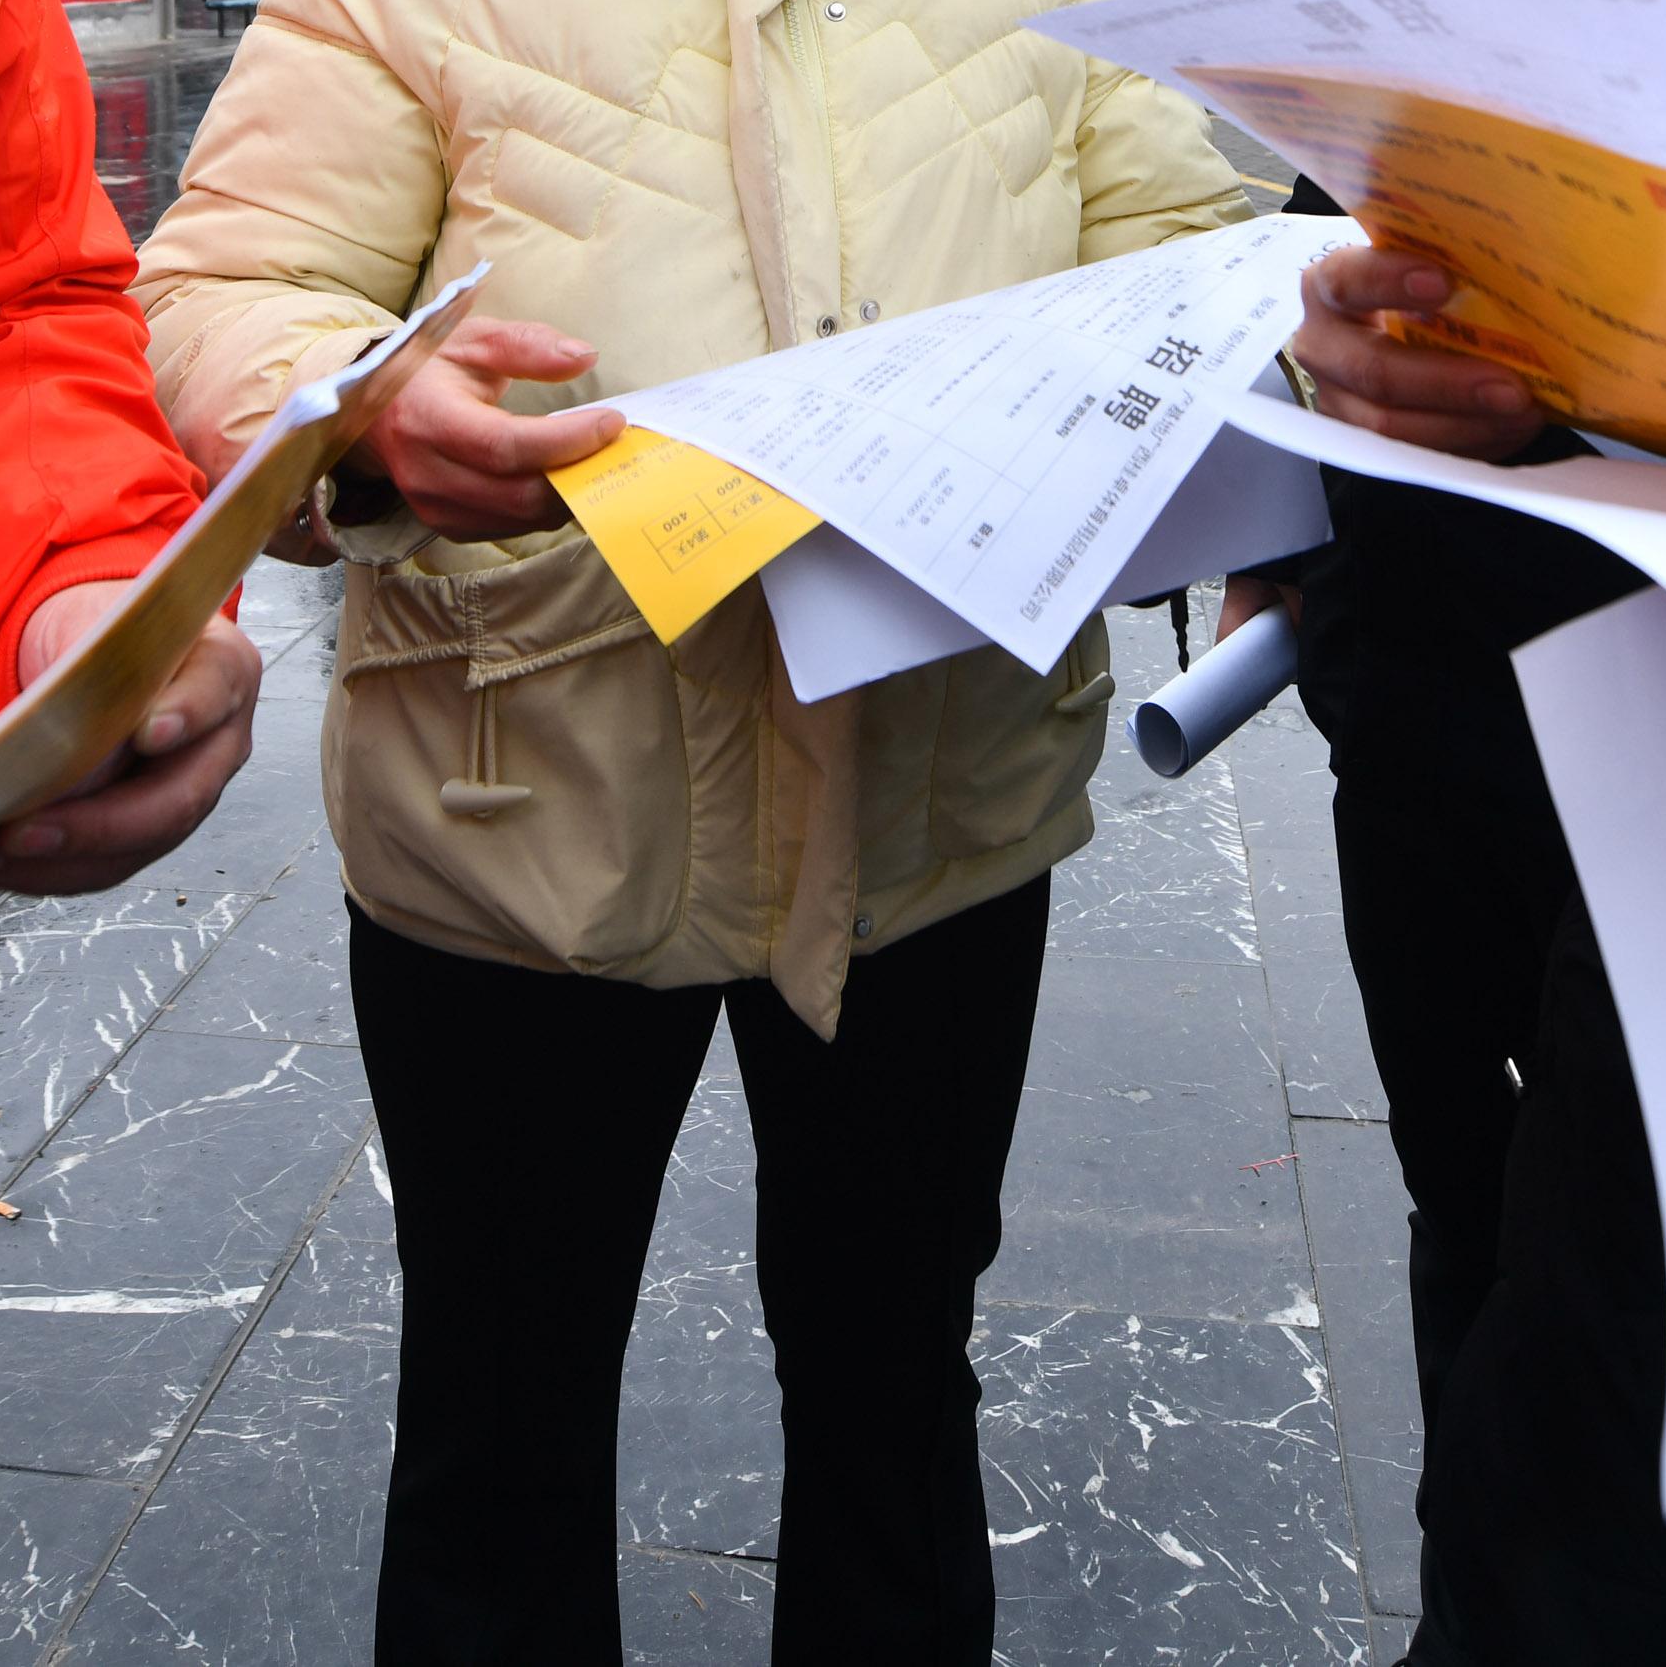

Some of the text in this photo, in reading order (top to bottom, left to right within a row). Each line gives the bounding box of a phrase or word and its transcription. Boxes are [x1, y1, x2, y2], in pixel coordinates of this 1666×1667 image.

[1099, 331, 1204, 434] 招聘
[715, 475, 743, 497] 600
[660, 510, 689, 534] 400
[673, 527, 710, 556] 第4天
